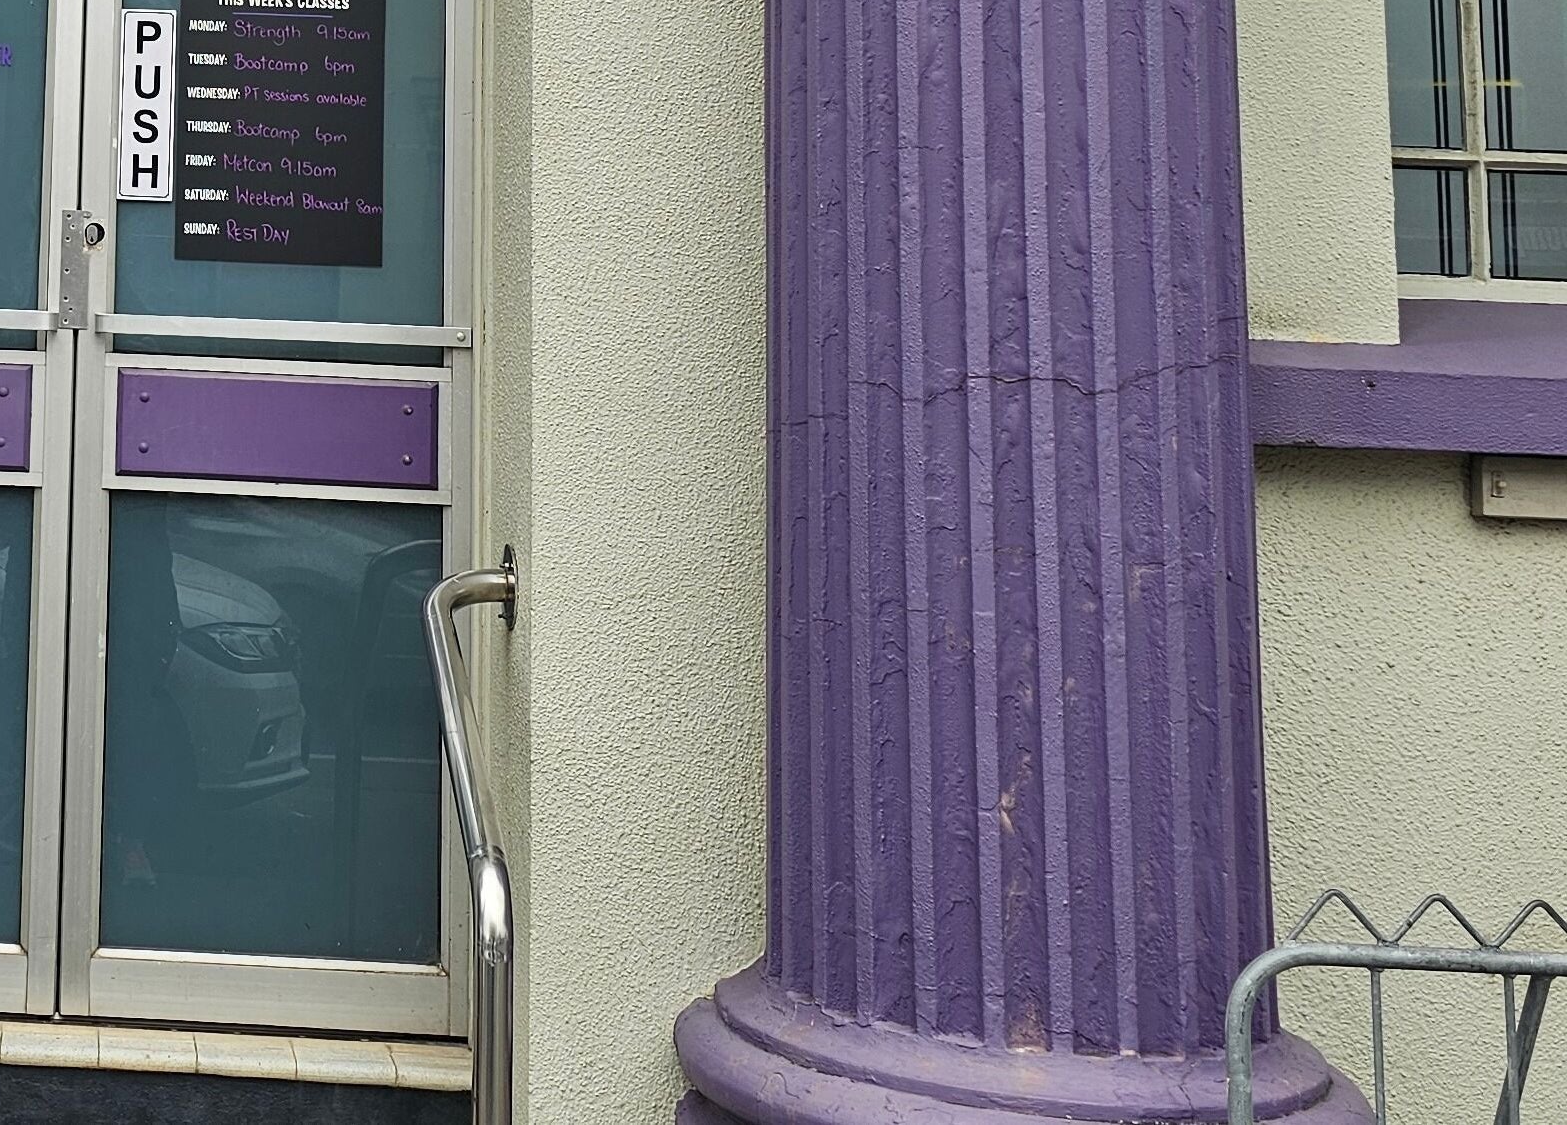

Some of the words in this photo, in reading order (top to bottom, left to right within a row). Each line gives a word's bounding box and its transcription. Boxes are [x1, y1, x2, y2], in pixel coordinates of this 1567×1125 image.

[189, 19, 228, 32] MONDAY:
[233, 20, 301, 46] Strength
[188, 53, 228, 66] TUESDAY:
[234, 53, 309, 75] Bootcamp
[324, 55, 355, 76] 6pm
[131, 20, 162, 189] PUSH
[187, 86, 241, 100] WEDNESDAY:
[244, 86, 260, 99] PT
[264, 89, 310, 103] sessions
[316, 93, 367, 107] available
[186, 120, 232, 133] THURSDAY:
[234, 119, 300, 146] Bootcamp
[315, 126, 348, 147] 6pm
[185, 154, 216, 167] FRIDAY:
[223, 153, 272, 173] Metcon
[281, 157, 337, 177] 9.15am
[184, 188, 229, 201] SATURDAY:
[235, 185, 294, 208] Weekend
[356, 198, 383, 215] 8am
[183, 222, 220, 235] SUNDAY:
